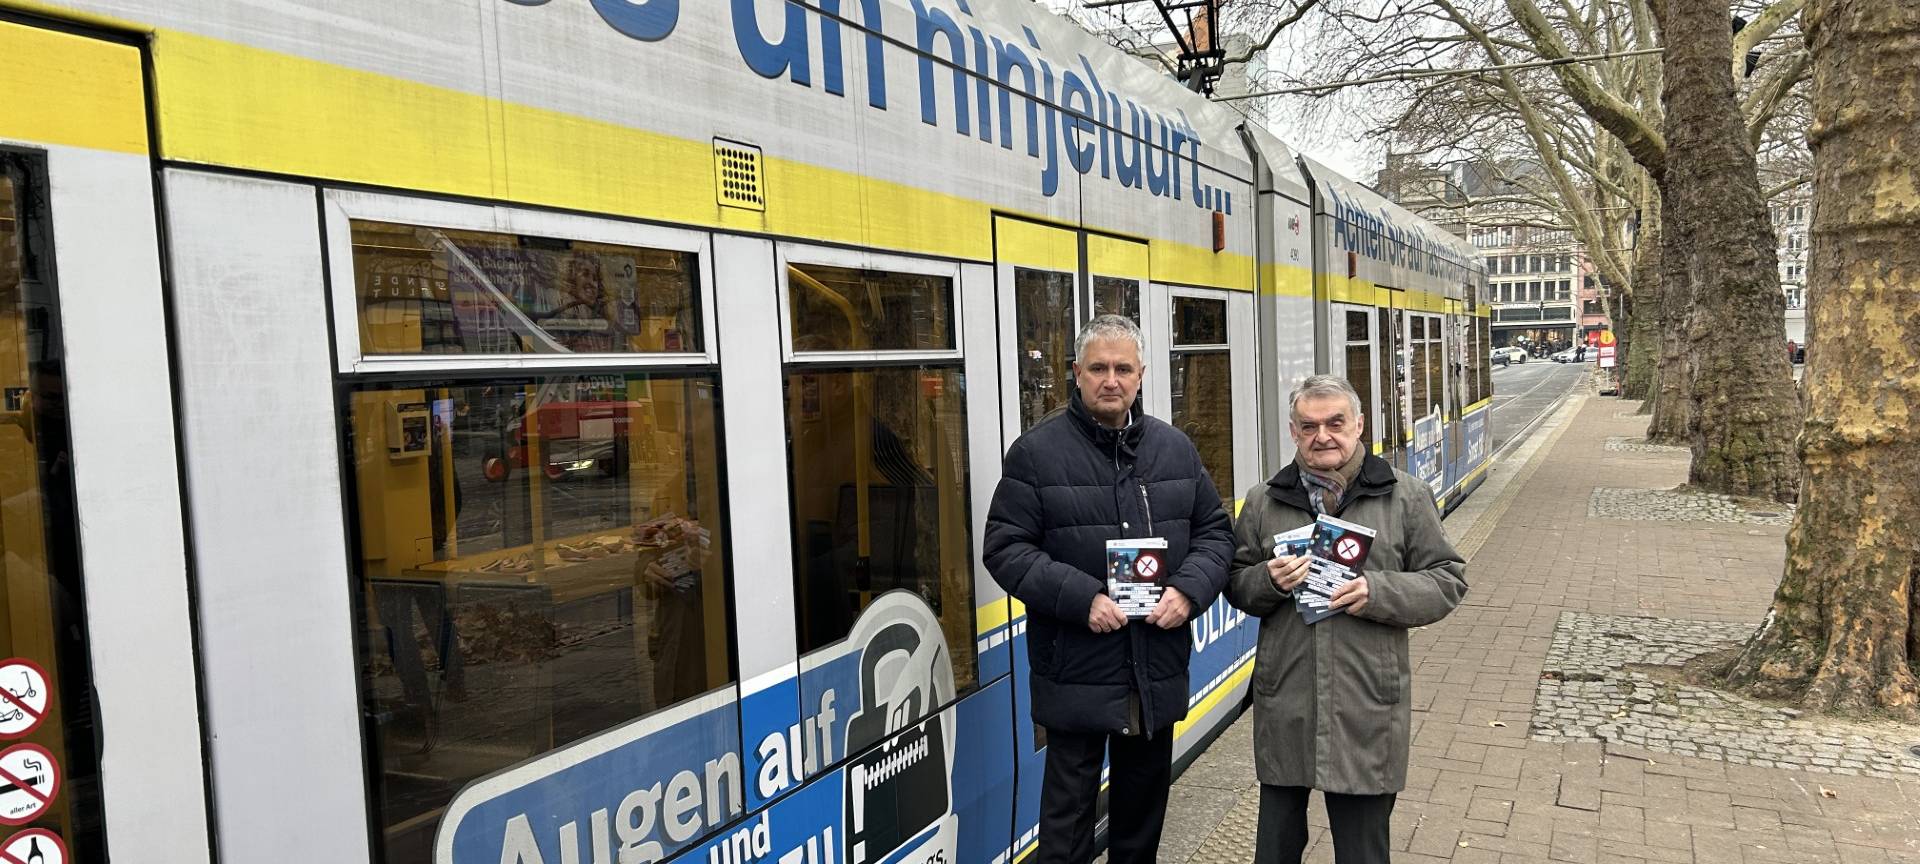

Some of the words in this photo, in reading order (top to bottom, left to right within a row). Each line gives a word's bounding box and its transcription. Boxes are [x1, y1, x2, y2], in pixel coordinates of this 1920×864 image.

[1326, 181, 1386, 263] Achten
[1407, 223, 1425, 273] auf
[10, 806, 24, 814] aller
[500, 751, 744, 864] Augen
[758, 688, 836, 799] auf
[710, 808, 771, 864] und
